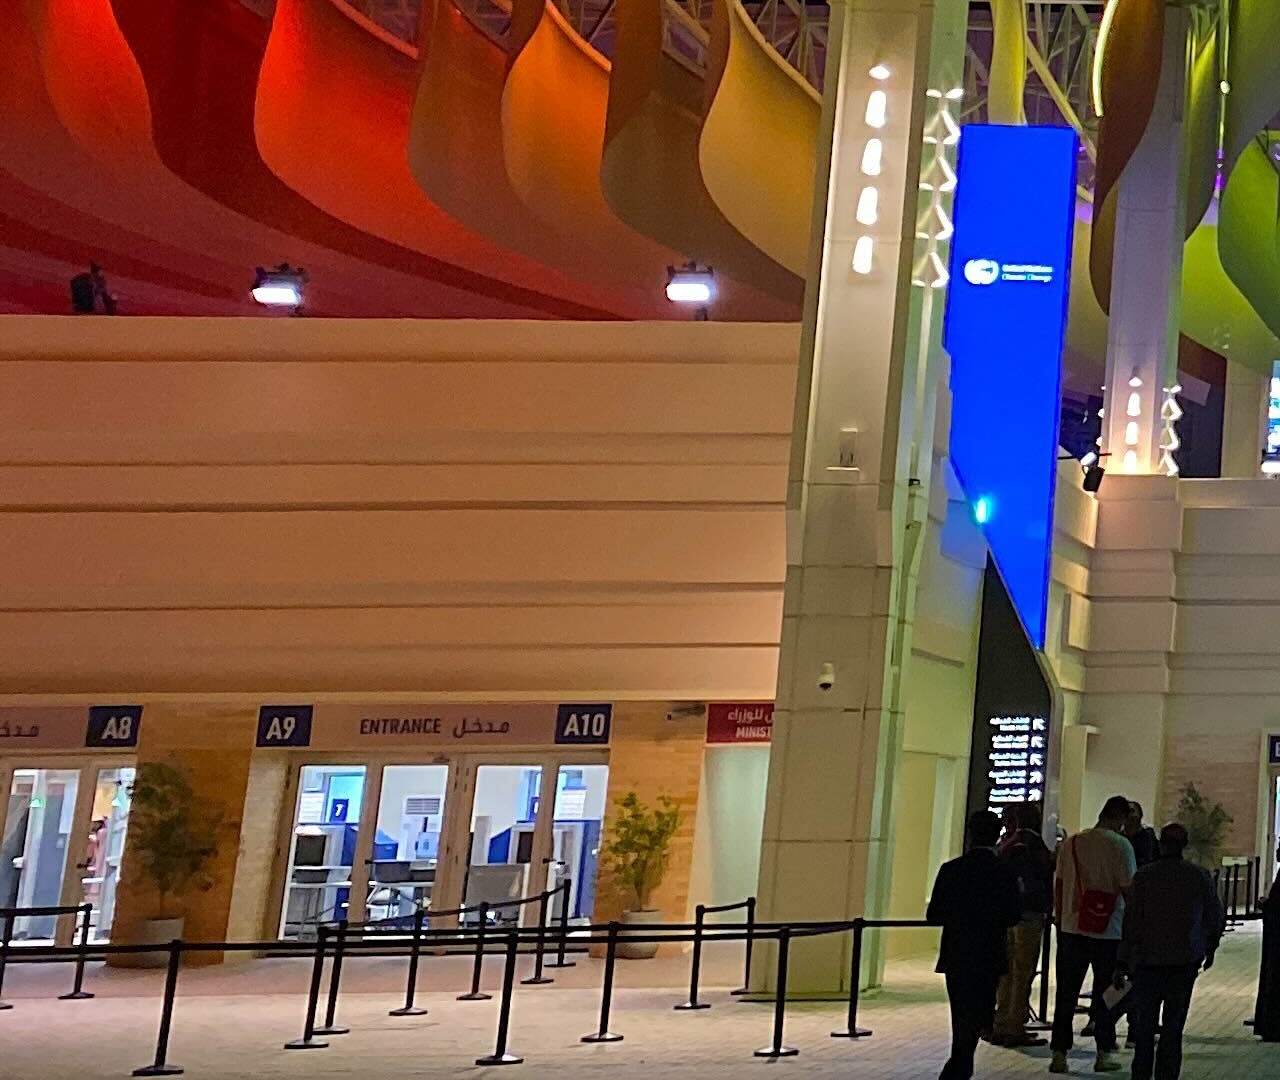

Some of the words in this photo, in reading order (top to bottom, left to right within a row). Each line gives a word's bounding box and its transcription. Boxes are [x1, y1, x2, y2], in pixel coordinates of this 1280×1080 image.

[101, 716, 132, 740] A8
[265, 716, 297, 740] A9
[360, 718, 441, 735] ENTRANCE
[452, 718, 510, 739] مدخل
[564, 713, 605, 737] A10
